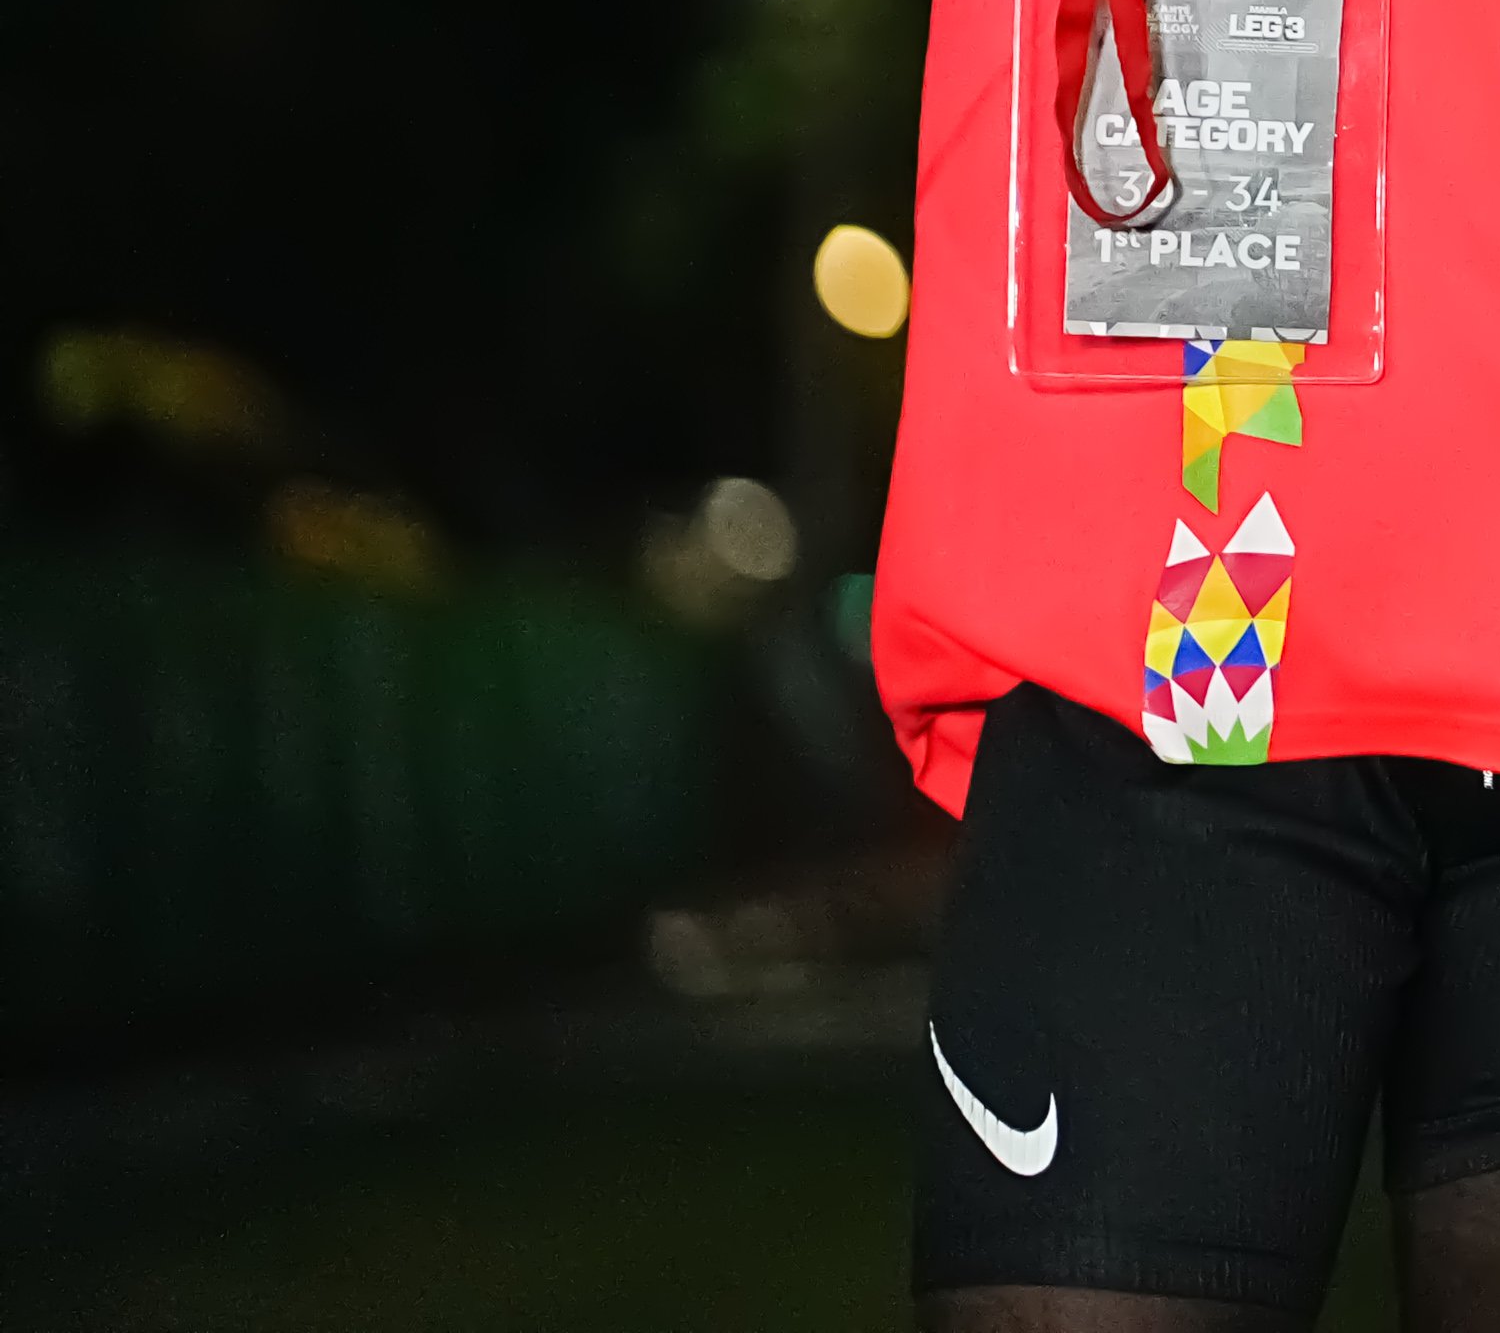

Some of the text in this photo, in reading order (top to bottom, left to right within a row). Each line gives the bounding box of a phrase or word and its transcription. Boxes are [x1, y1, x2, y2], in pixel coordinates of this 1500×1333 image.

[1152, 78, 1252, 119] AGE
[1225, 175, 1282, 214] 34
[1094, 228, 1301, 271] 1st PLACE
